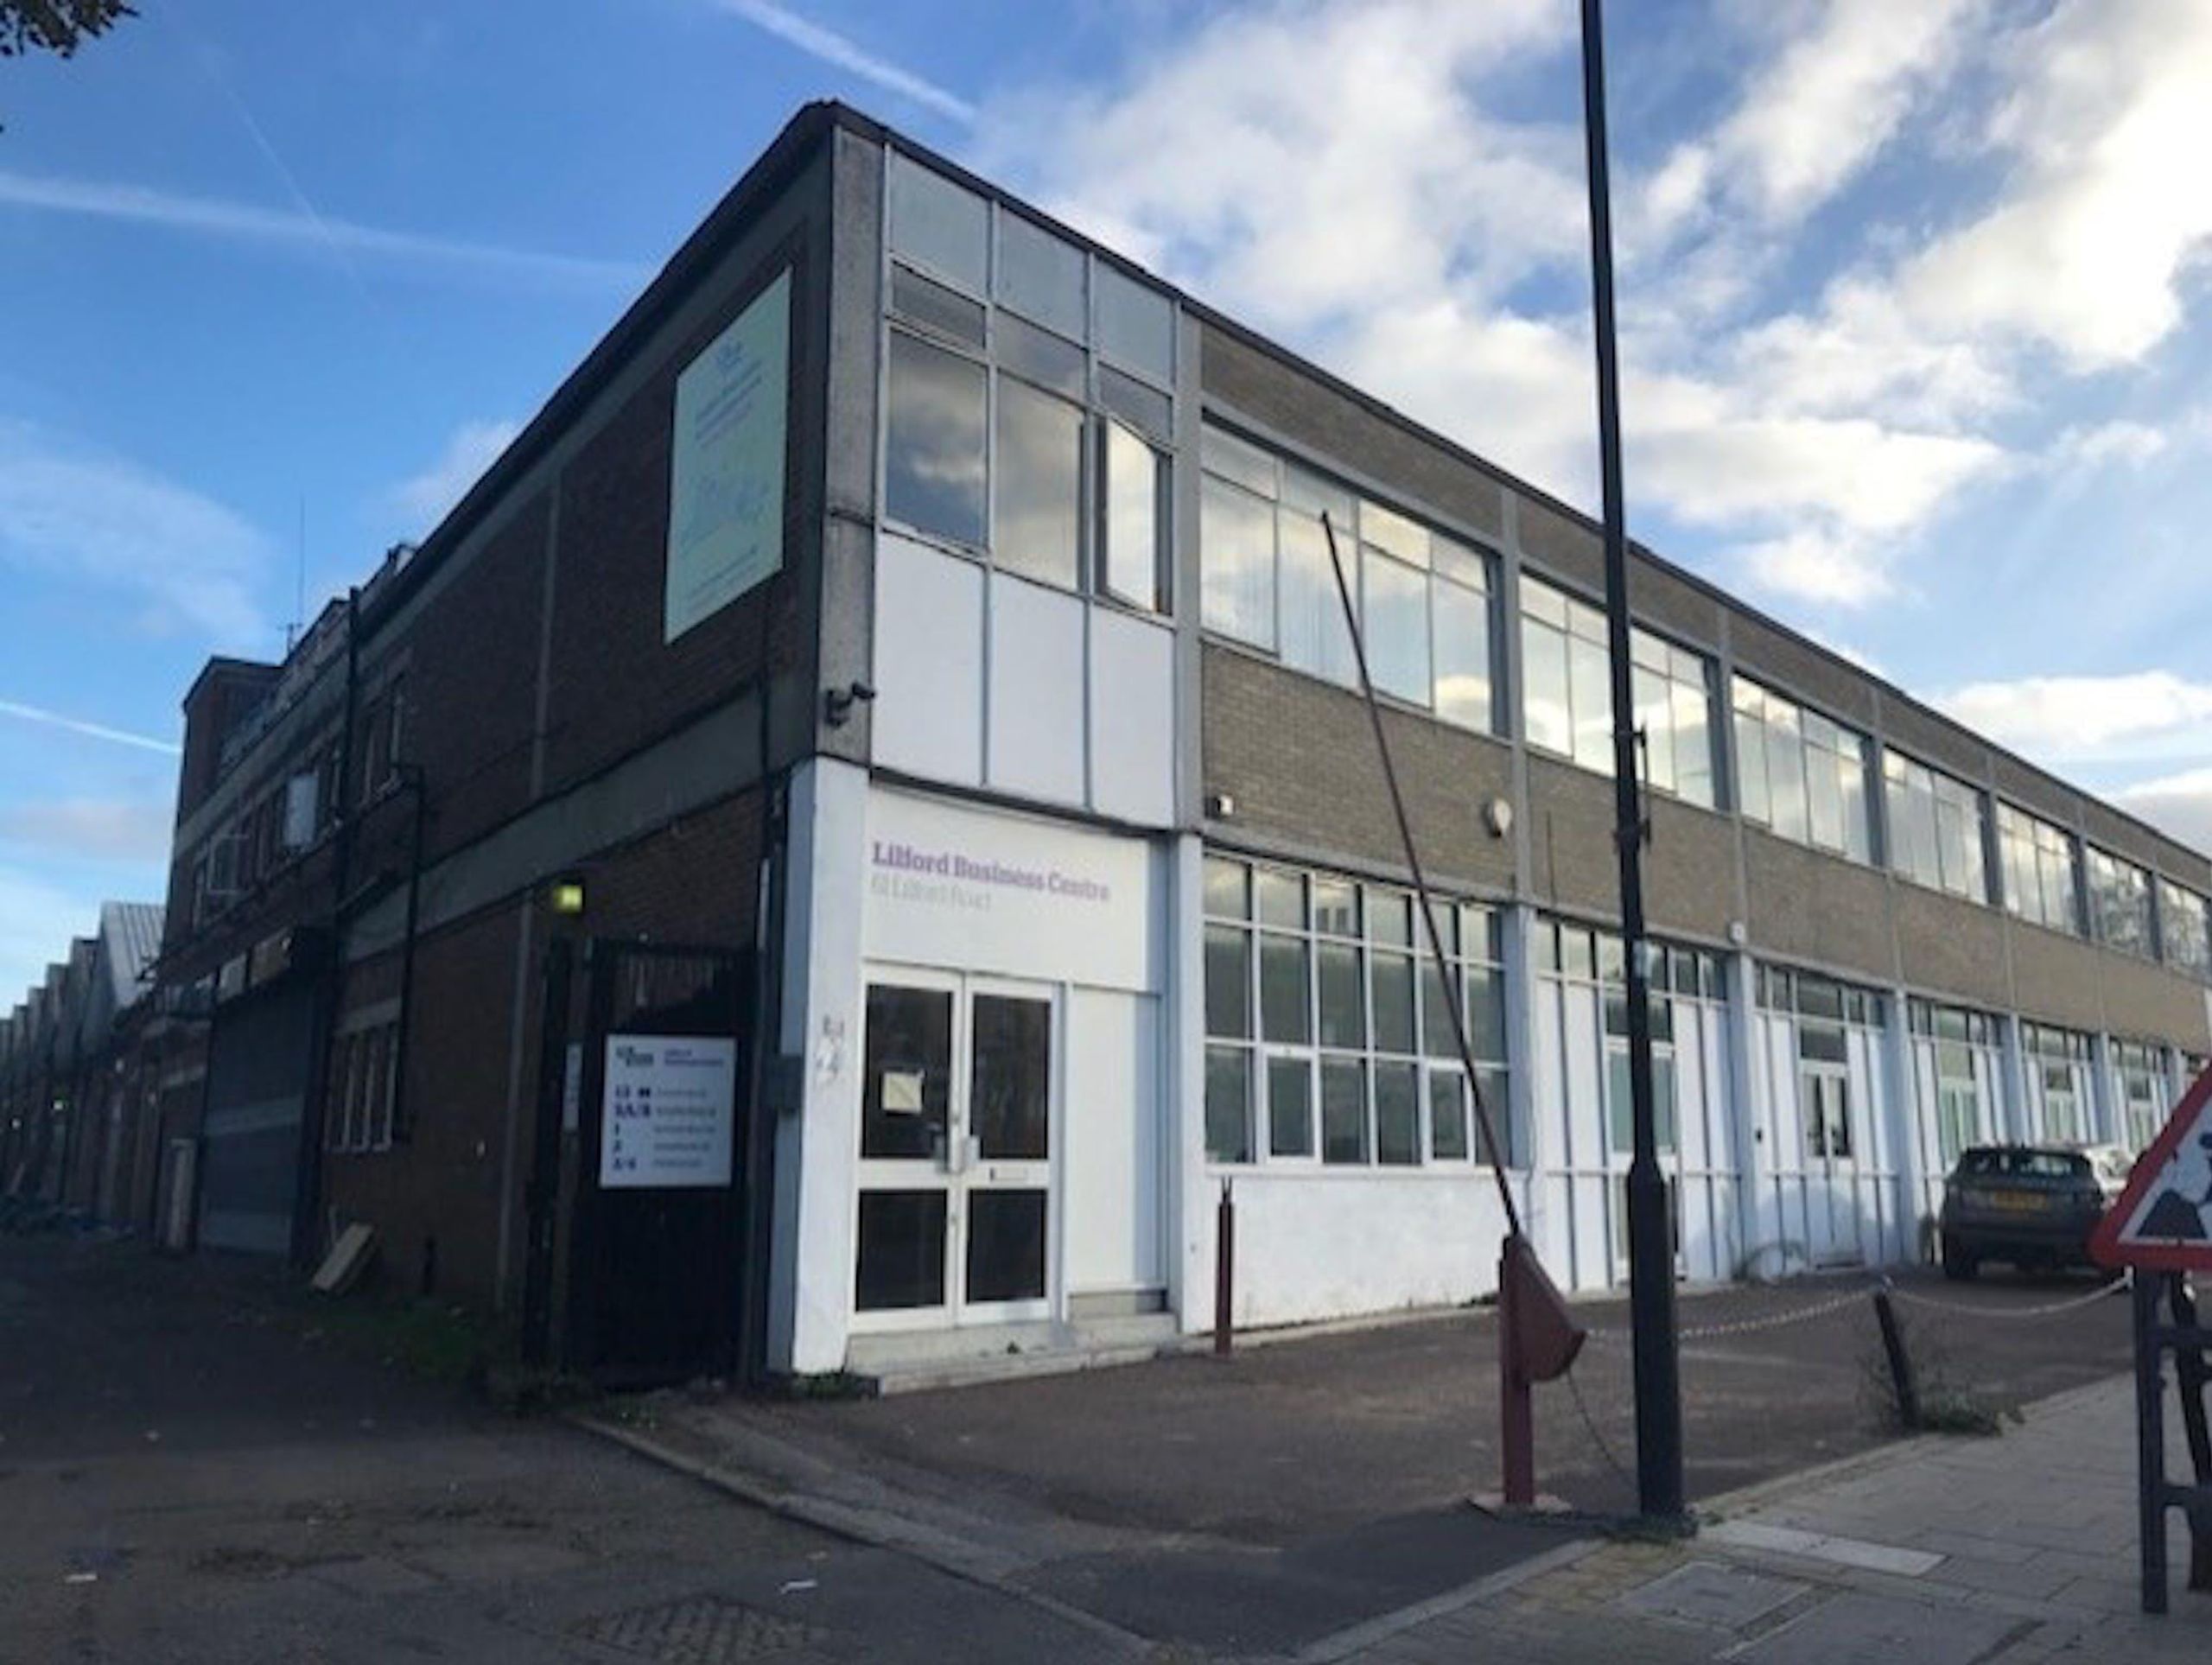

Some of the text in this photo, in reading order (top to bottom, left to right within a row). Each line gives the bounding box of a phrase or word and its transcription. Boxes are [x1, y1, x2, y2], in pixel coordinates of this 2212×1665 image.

[872, 841, 1109, 902] Lilford Business Centre
